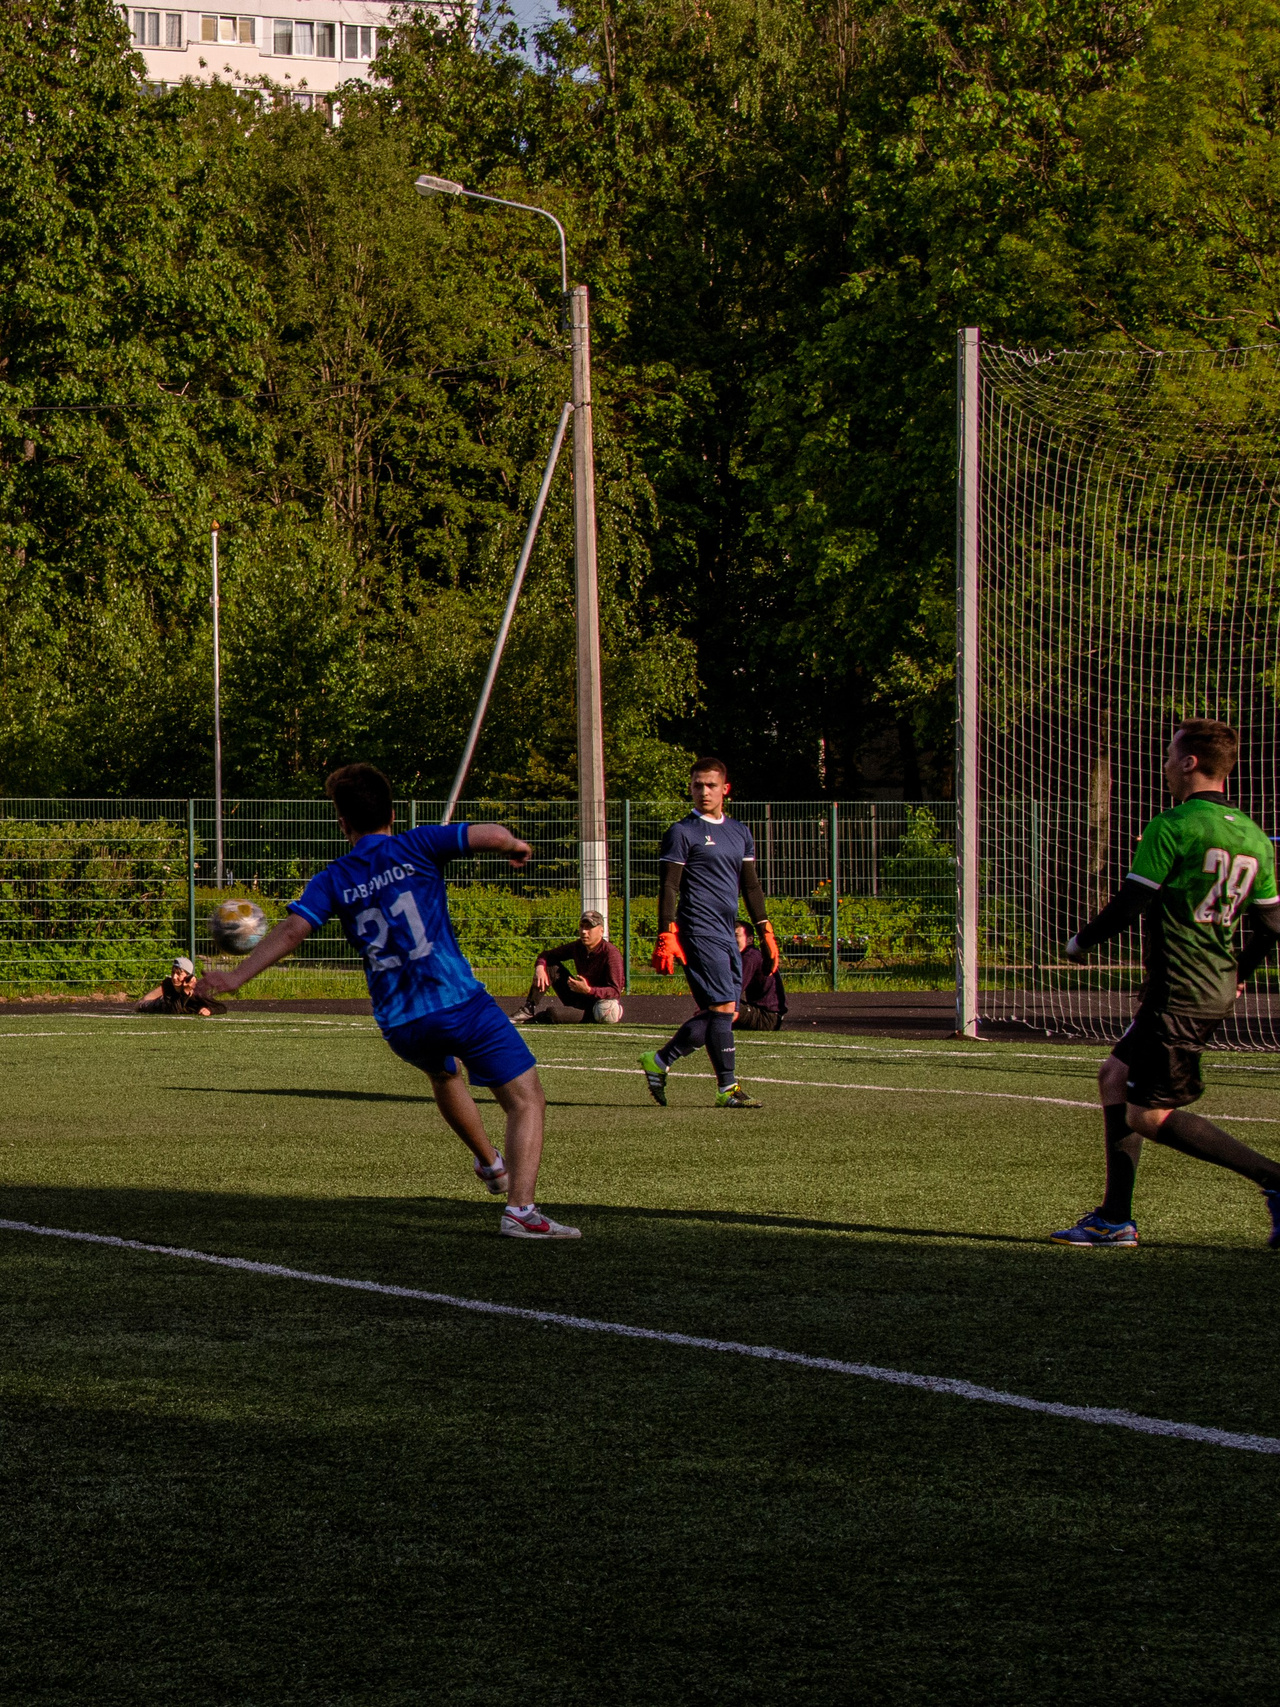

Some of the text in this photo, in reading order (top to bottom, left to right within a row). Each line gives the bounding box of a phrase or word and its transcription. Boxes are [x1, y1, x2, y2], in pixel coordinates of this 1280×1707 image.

[343, 863, 416, 904] ГАВРИЛОВ
[1194, 847, 1259, 927] 29
[355, 890, 434, 972] 21
